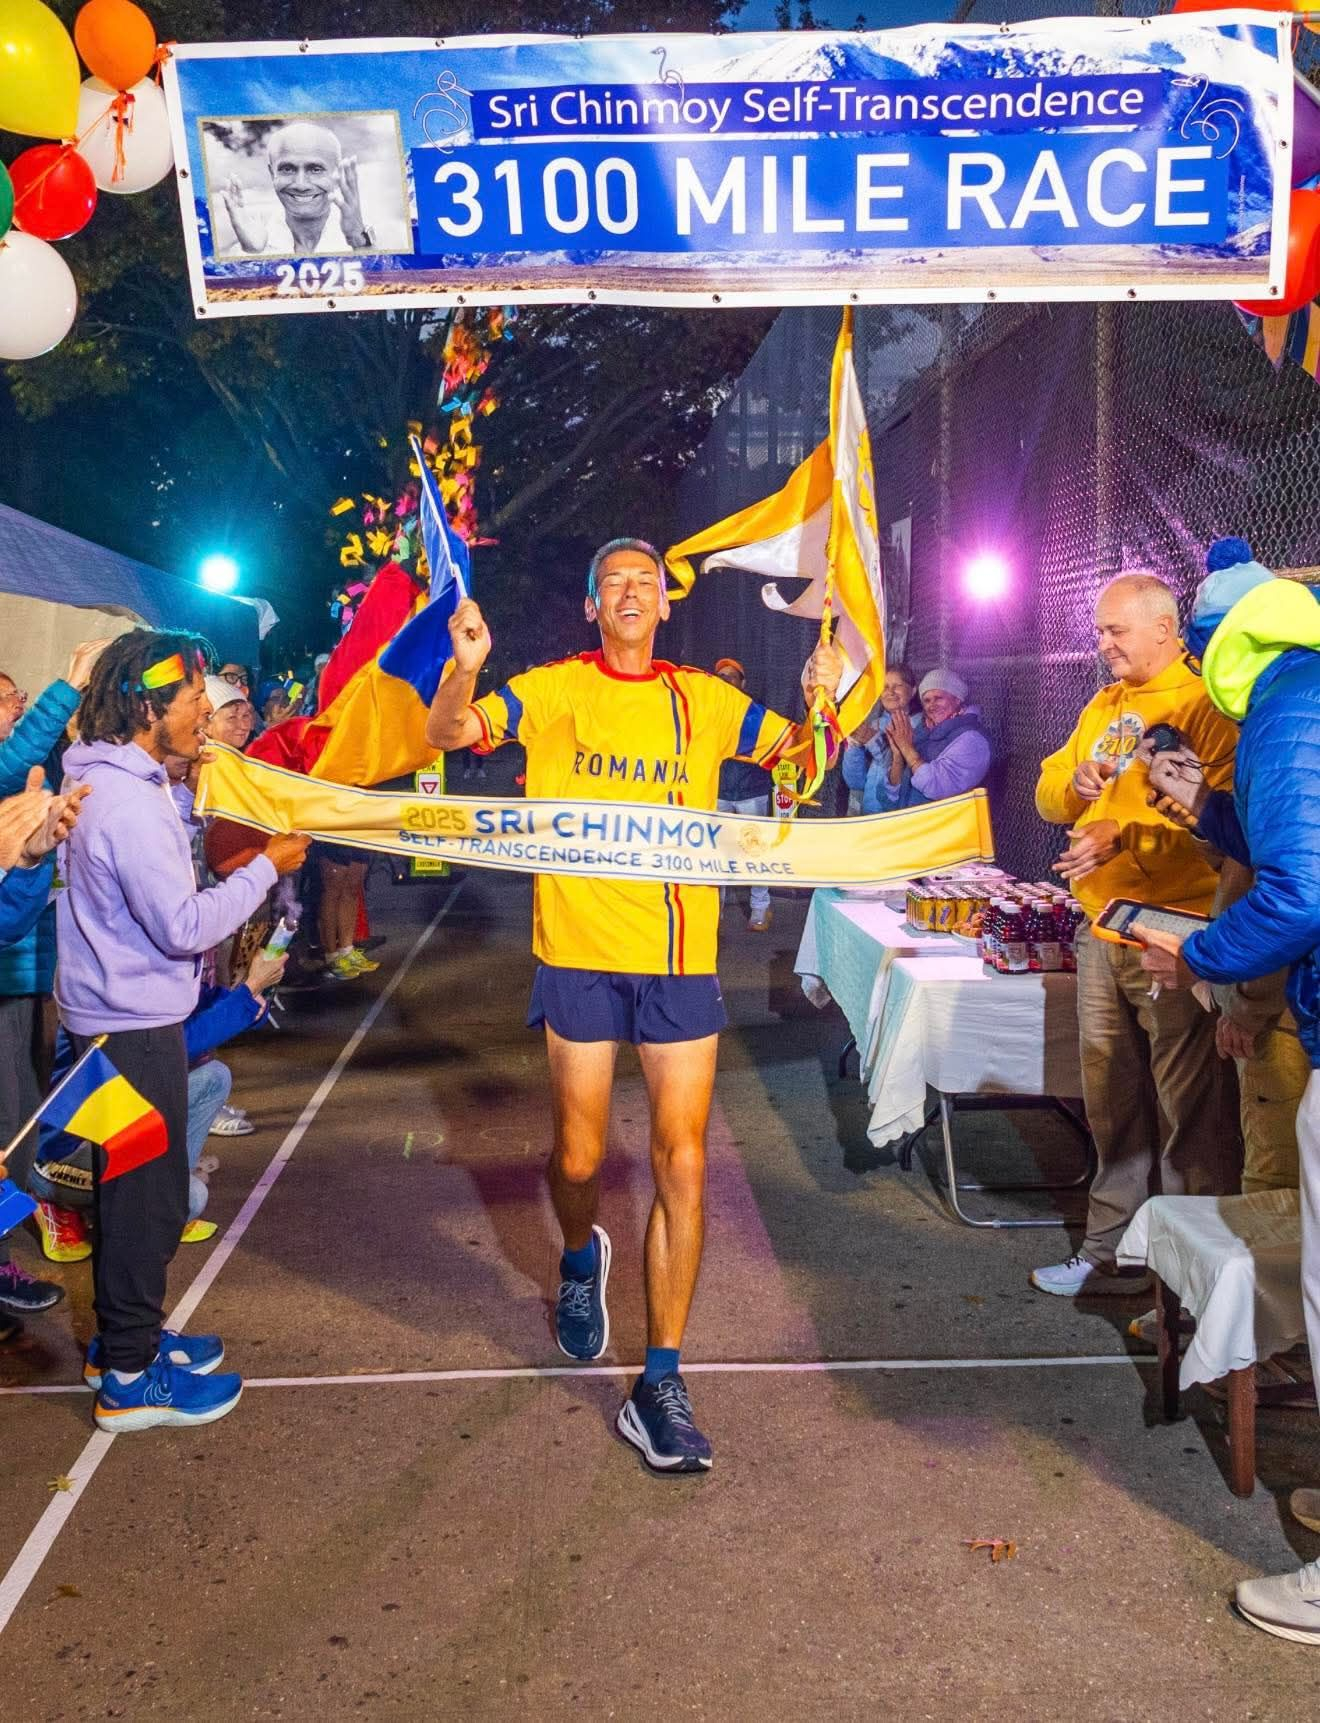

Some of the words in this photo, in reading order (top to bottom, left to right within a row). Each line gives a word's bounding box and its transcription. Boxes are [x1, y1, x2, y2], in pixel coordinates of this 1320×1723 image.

[489, 94, 538, 129] Sri
[550, 90, 732, 132] Chinmoy
[742, 83, 1144, 123] Self-Transcendence
[434, 157, 639, 237] 3100
[675, 153, 910, 236] MILE
[946, 146, 1212, 231] RACE
[275, 262, 365, 295] 2025
[575, 751, 688, 783] ROMANIA
[406, 806, 466, 831] 2025
[475, 809, 536, 834] SRI
[552, 811, 722, 849] CHINMOY
[399, 829, 642, 867] SELF-TRANSCENDENCE
[651, 852, 694, 871] 3100
[699, 858, 742, 875] MILE
[745, 860, 795, 876] RACE
